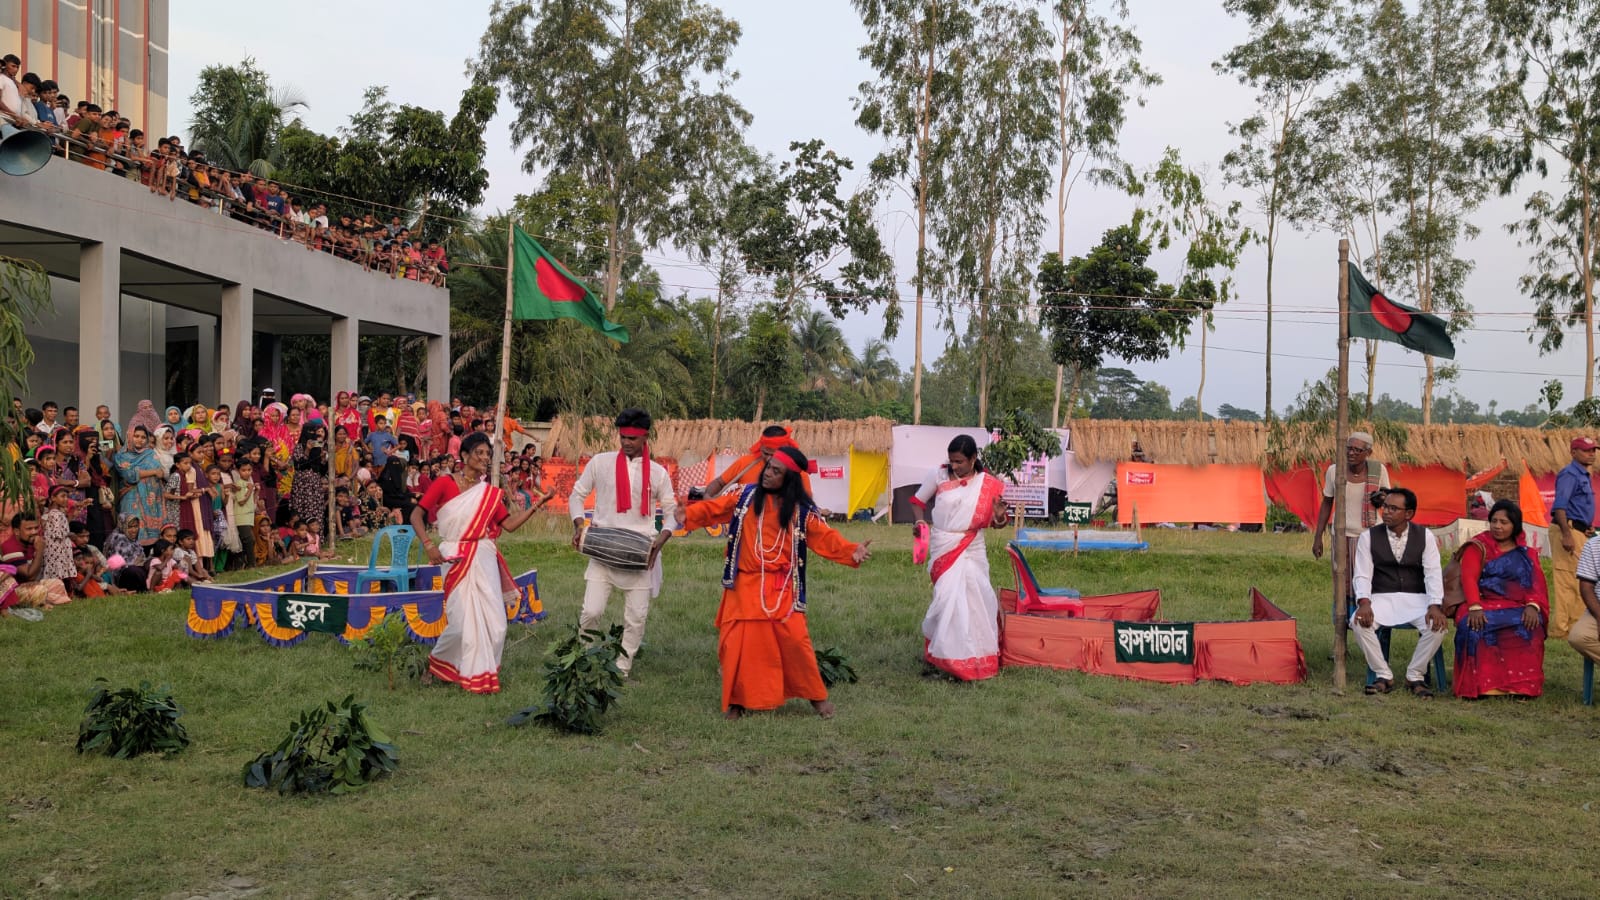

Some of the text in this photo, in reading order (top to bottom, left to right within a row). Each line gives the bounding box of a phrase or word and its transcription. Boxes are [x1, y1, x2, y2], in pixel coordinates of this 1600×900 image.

[1064, 505, 1090, 522] পুকুর
[286, 600, 331, 630] স্কুল
[1117, 625, 1189, 656] হাসপাতাল
